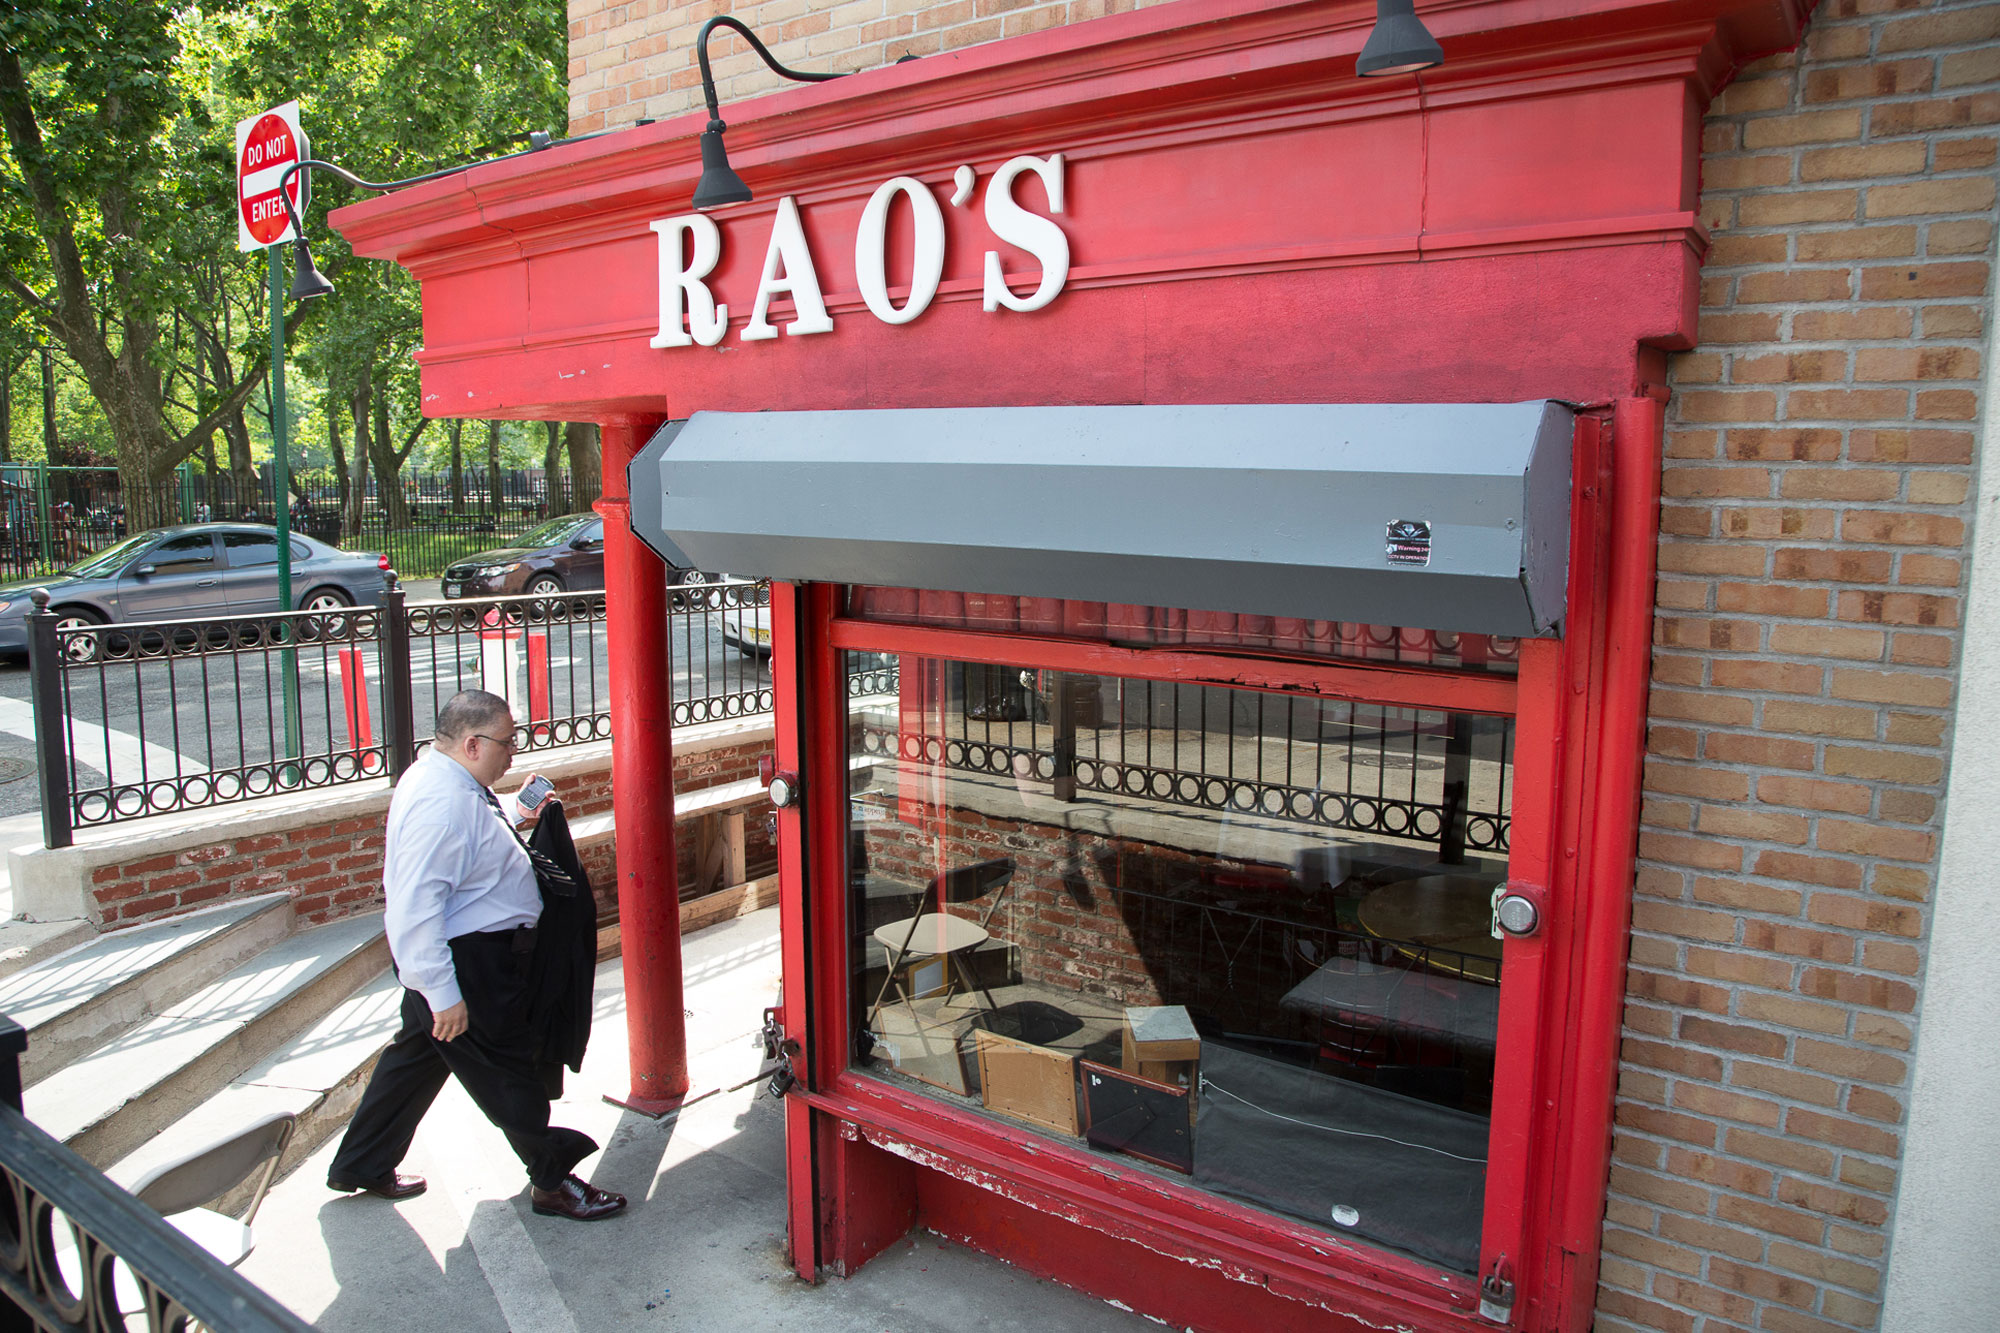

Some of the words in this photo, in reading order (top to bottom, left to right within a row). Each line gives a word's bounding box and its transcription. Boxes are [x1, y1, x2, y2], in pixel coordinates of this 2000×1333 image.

[248, 144, 262, 167] DO
[266, 135, 288, 161] NOT
[252, 195, 287, 223] ENTER
[649, 153, 1070, 349] RAO'S
